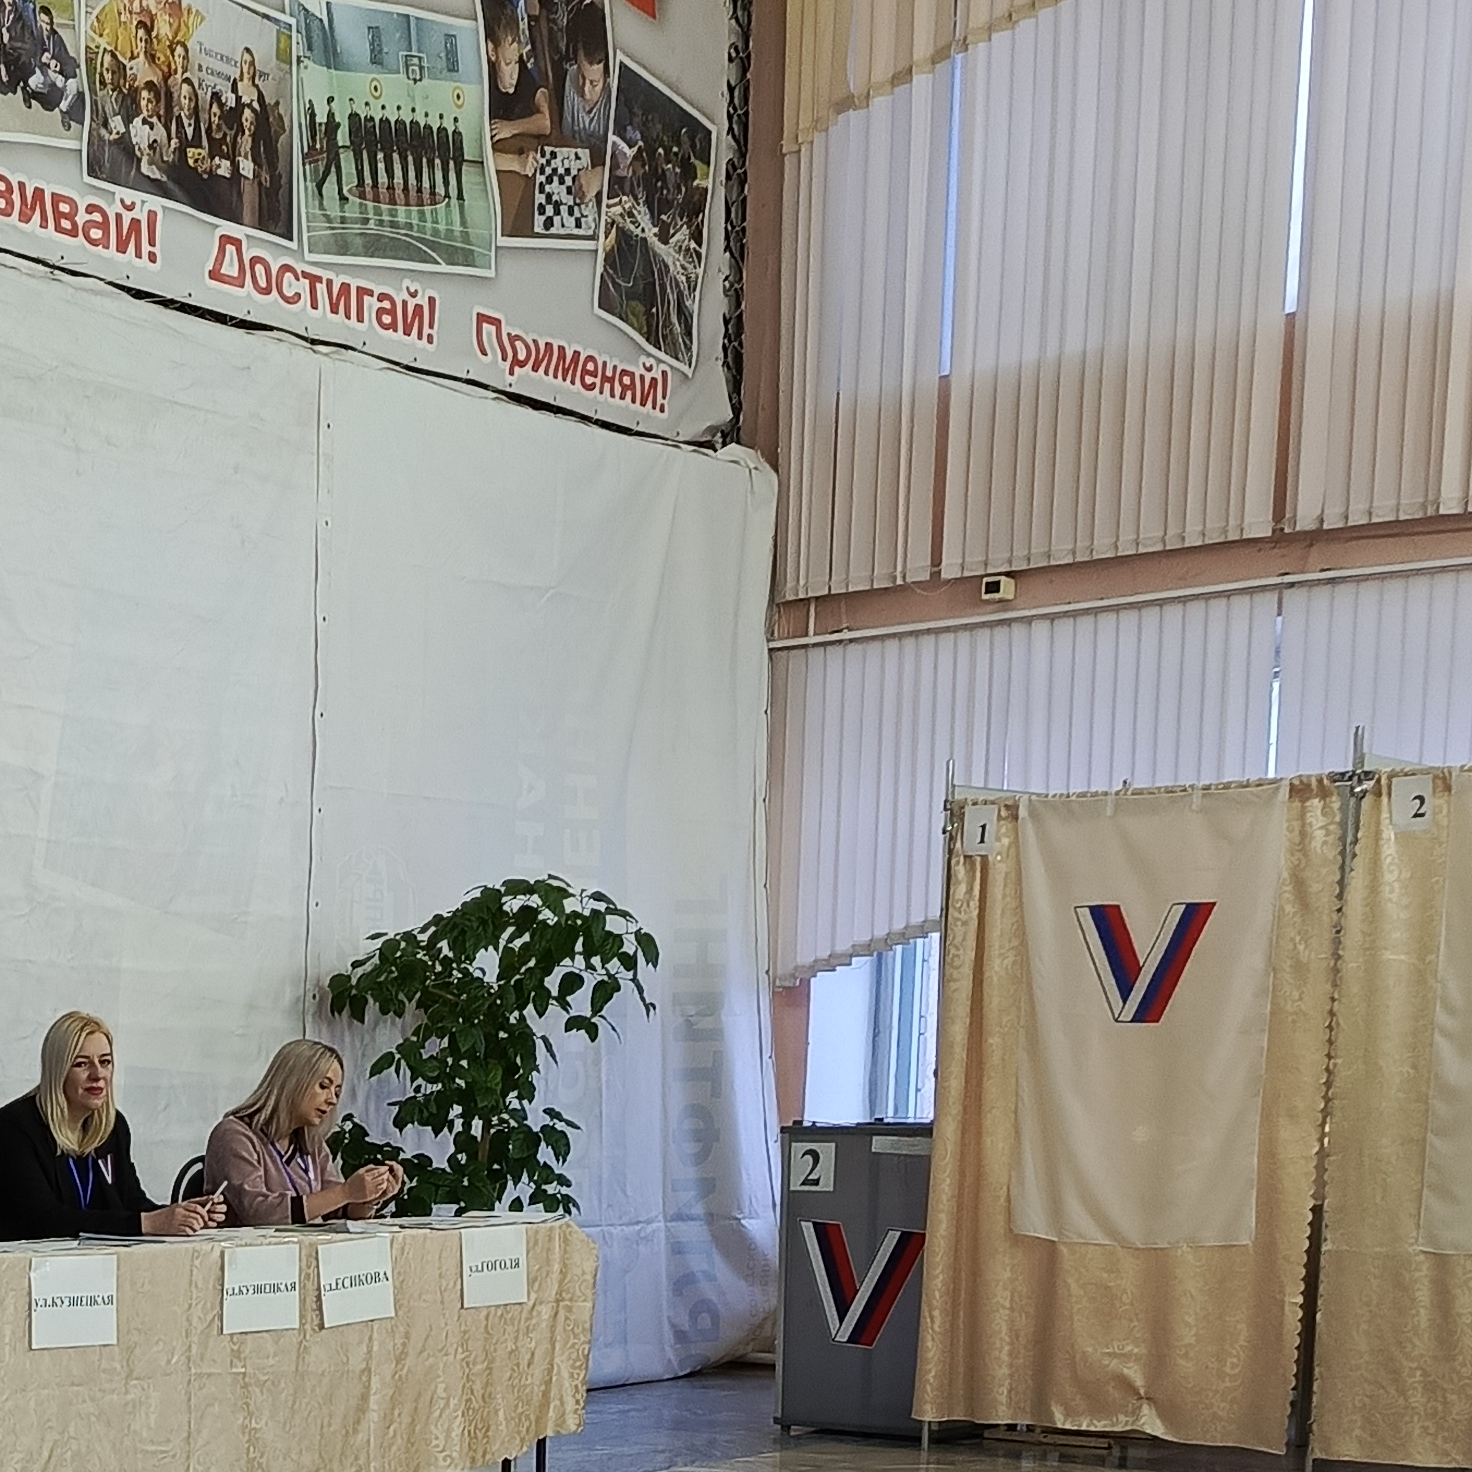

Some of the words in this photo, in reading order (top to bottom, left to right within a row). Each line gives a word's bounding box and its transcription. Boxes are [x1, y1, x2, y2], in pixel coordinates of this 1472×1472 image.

[208, 233, 437, 345] Достигай!
[475, 311, 668, 413] Применяй!
[1410, 794, 1427, 819] 2
[976, 822, 989, 846] 1
[799, 1148, 822, 1187] 2
